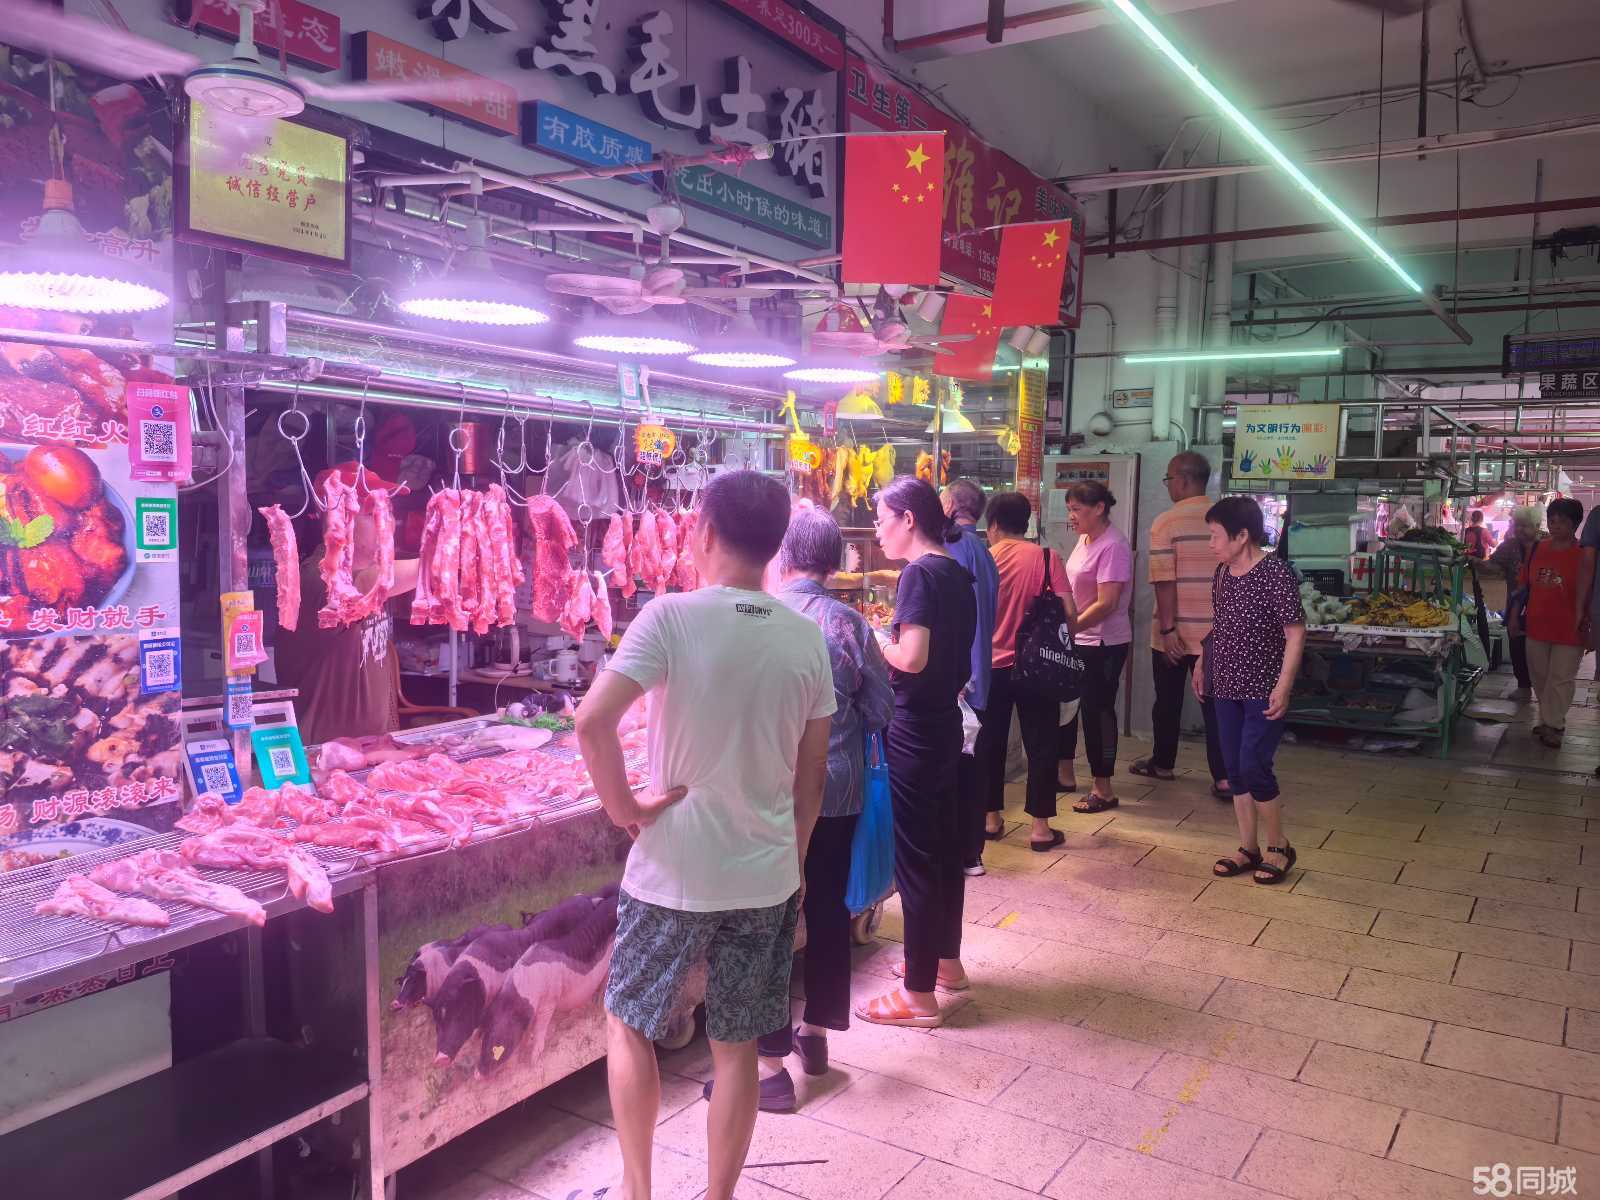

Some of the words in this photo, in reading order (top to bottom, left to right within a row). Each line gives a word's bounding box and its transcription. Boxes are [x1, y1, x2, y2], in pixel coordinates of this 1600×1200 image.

[848, 66, 929, 129] 卫生第一
[226, 175, 317, 212] 诚信经营户
[1540, 372, 1600, 391] 果蔬区
[26, 604, 169, 633] 发财就手
[29, 775, 178, 824] 财源滚滚来
